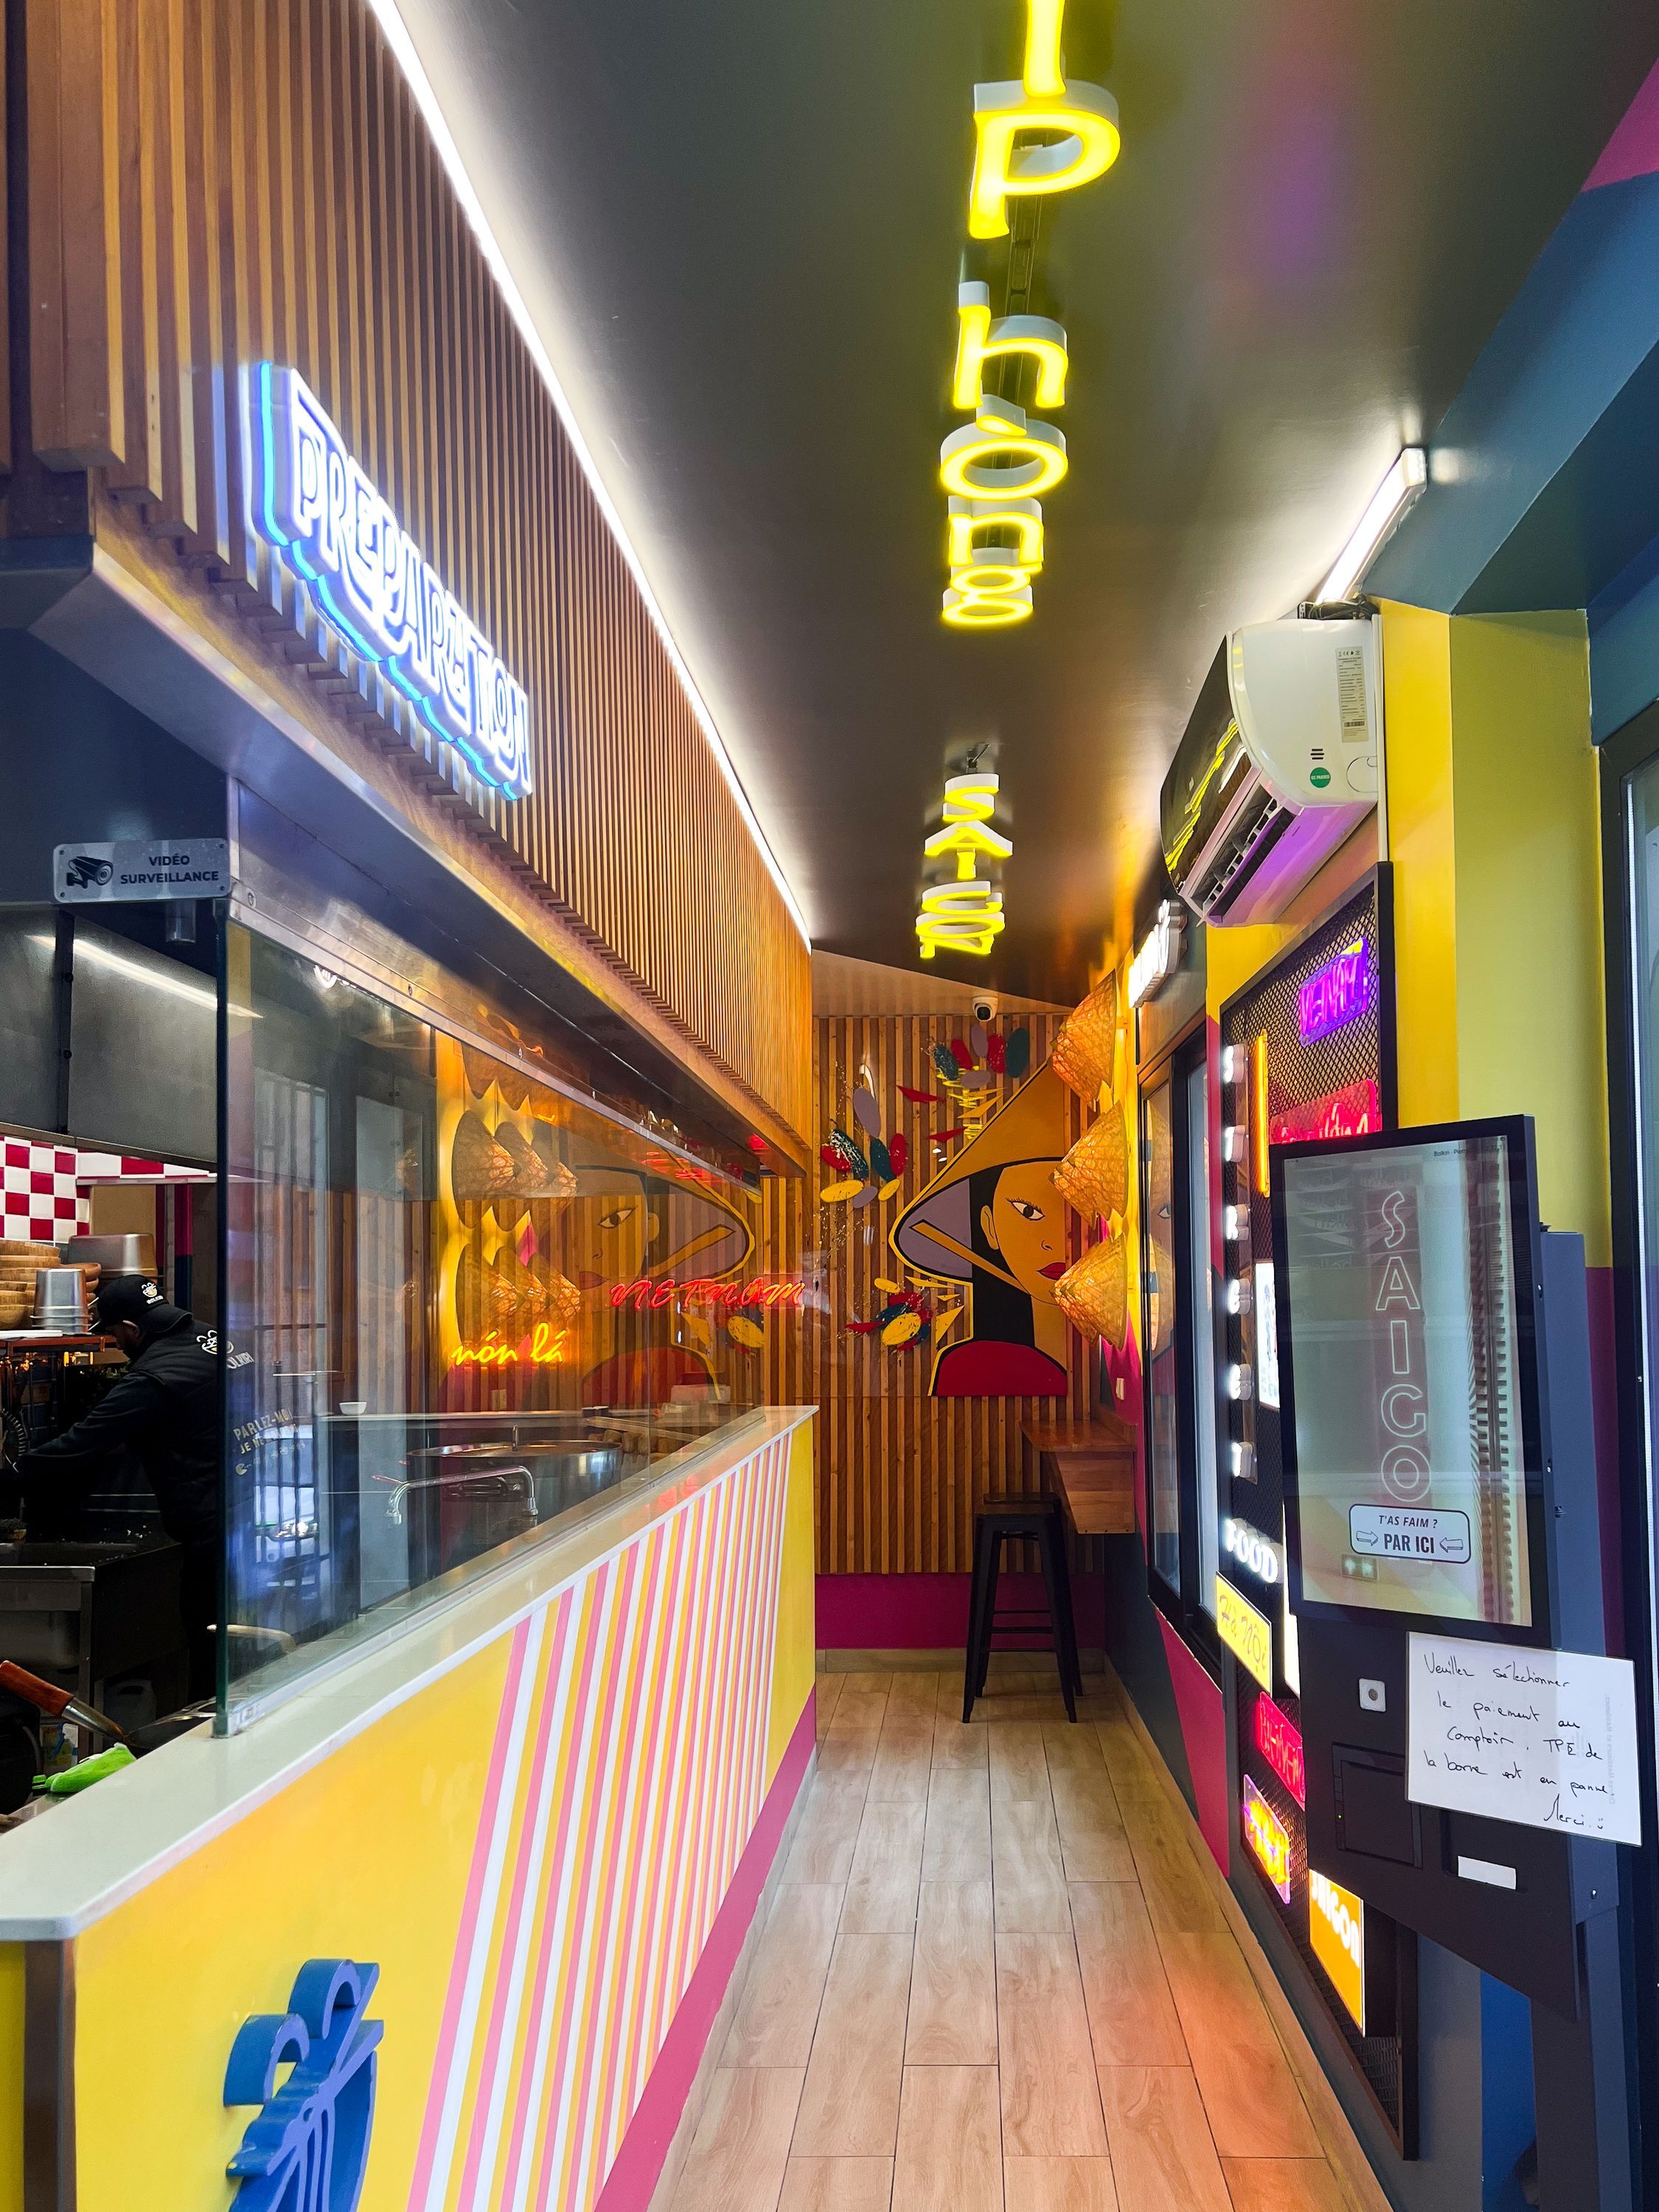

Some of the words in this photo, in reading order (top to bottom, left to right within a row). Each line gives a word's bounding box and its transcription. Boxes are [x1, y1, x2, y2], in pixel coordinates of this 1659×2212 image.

[120, 870, 219, 885] SURVEILLANCE
[148, 853, 190, 866] VIDÉO
[915, 773, 1014, 959] SAIGON
[226, 1352, 255, 1370] OLKIRI
[451, 1329, 518, 1366] nón
[531, 1321, 568, 1364] lá
[1375, 1190, 1433, 1502] SAIGO
[1379, 1514, 1400, 1526] T'AS
[1403, 1517, 1430, 1528] FAIM
[1433, 1518, 1439, 1529] ?
[1225, 1517, 1281, 1584] FOOD
[1384, 1533, 1411, 1552] PAR
[1416, 1536, 1435, 1554] ICI
[1424, 1652, 1475, 1677] Veuillez
[1492, 1660, 1571, 1688] sélectionner
[1437, 1691, 1452, 1708] le
[1472, 1701, 1540, 1722] paiement
[1557, 1719, 1581, 1728] au
[1543, 1739, 1576, 1756] TPE
[1585, 1742, 1603, 1760] de
[1424, 1750, 1437, 1767] la
[1444, 1752, 1488, 1775] borne
[1502, 1761, 1523, 1779] est
[1540, 1776, 1557, 1786] en
